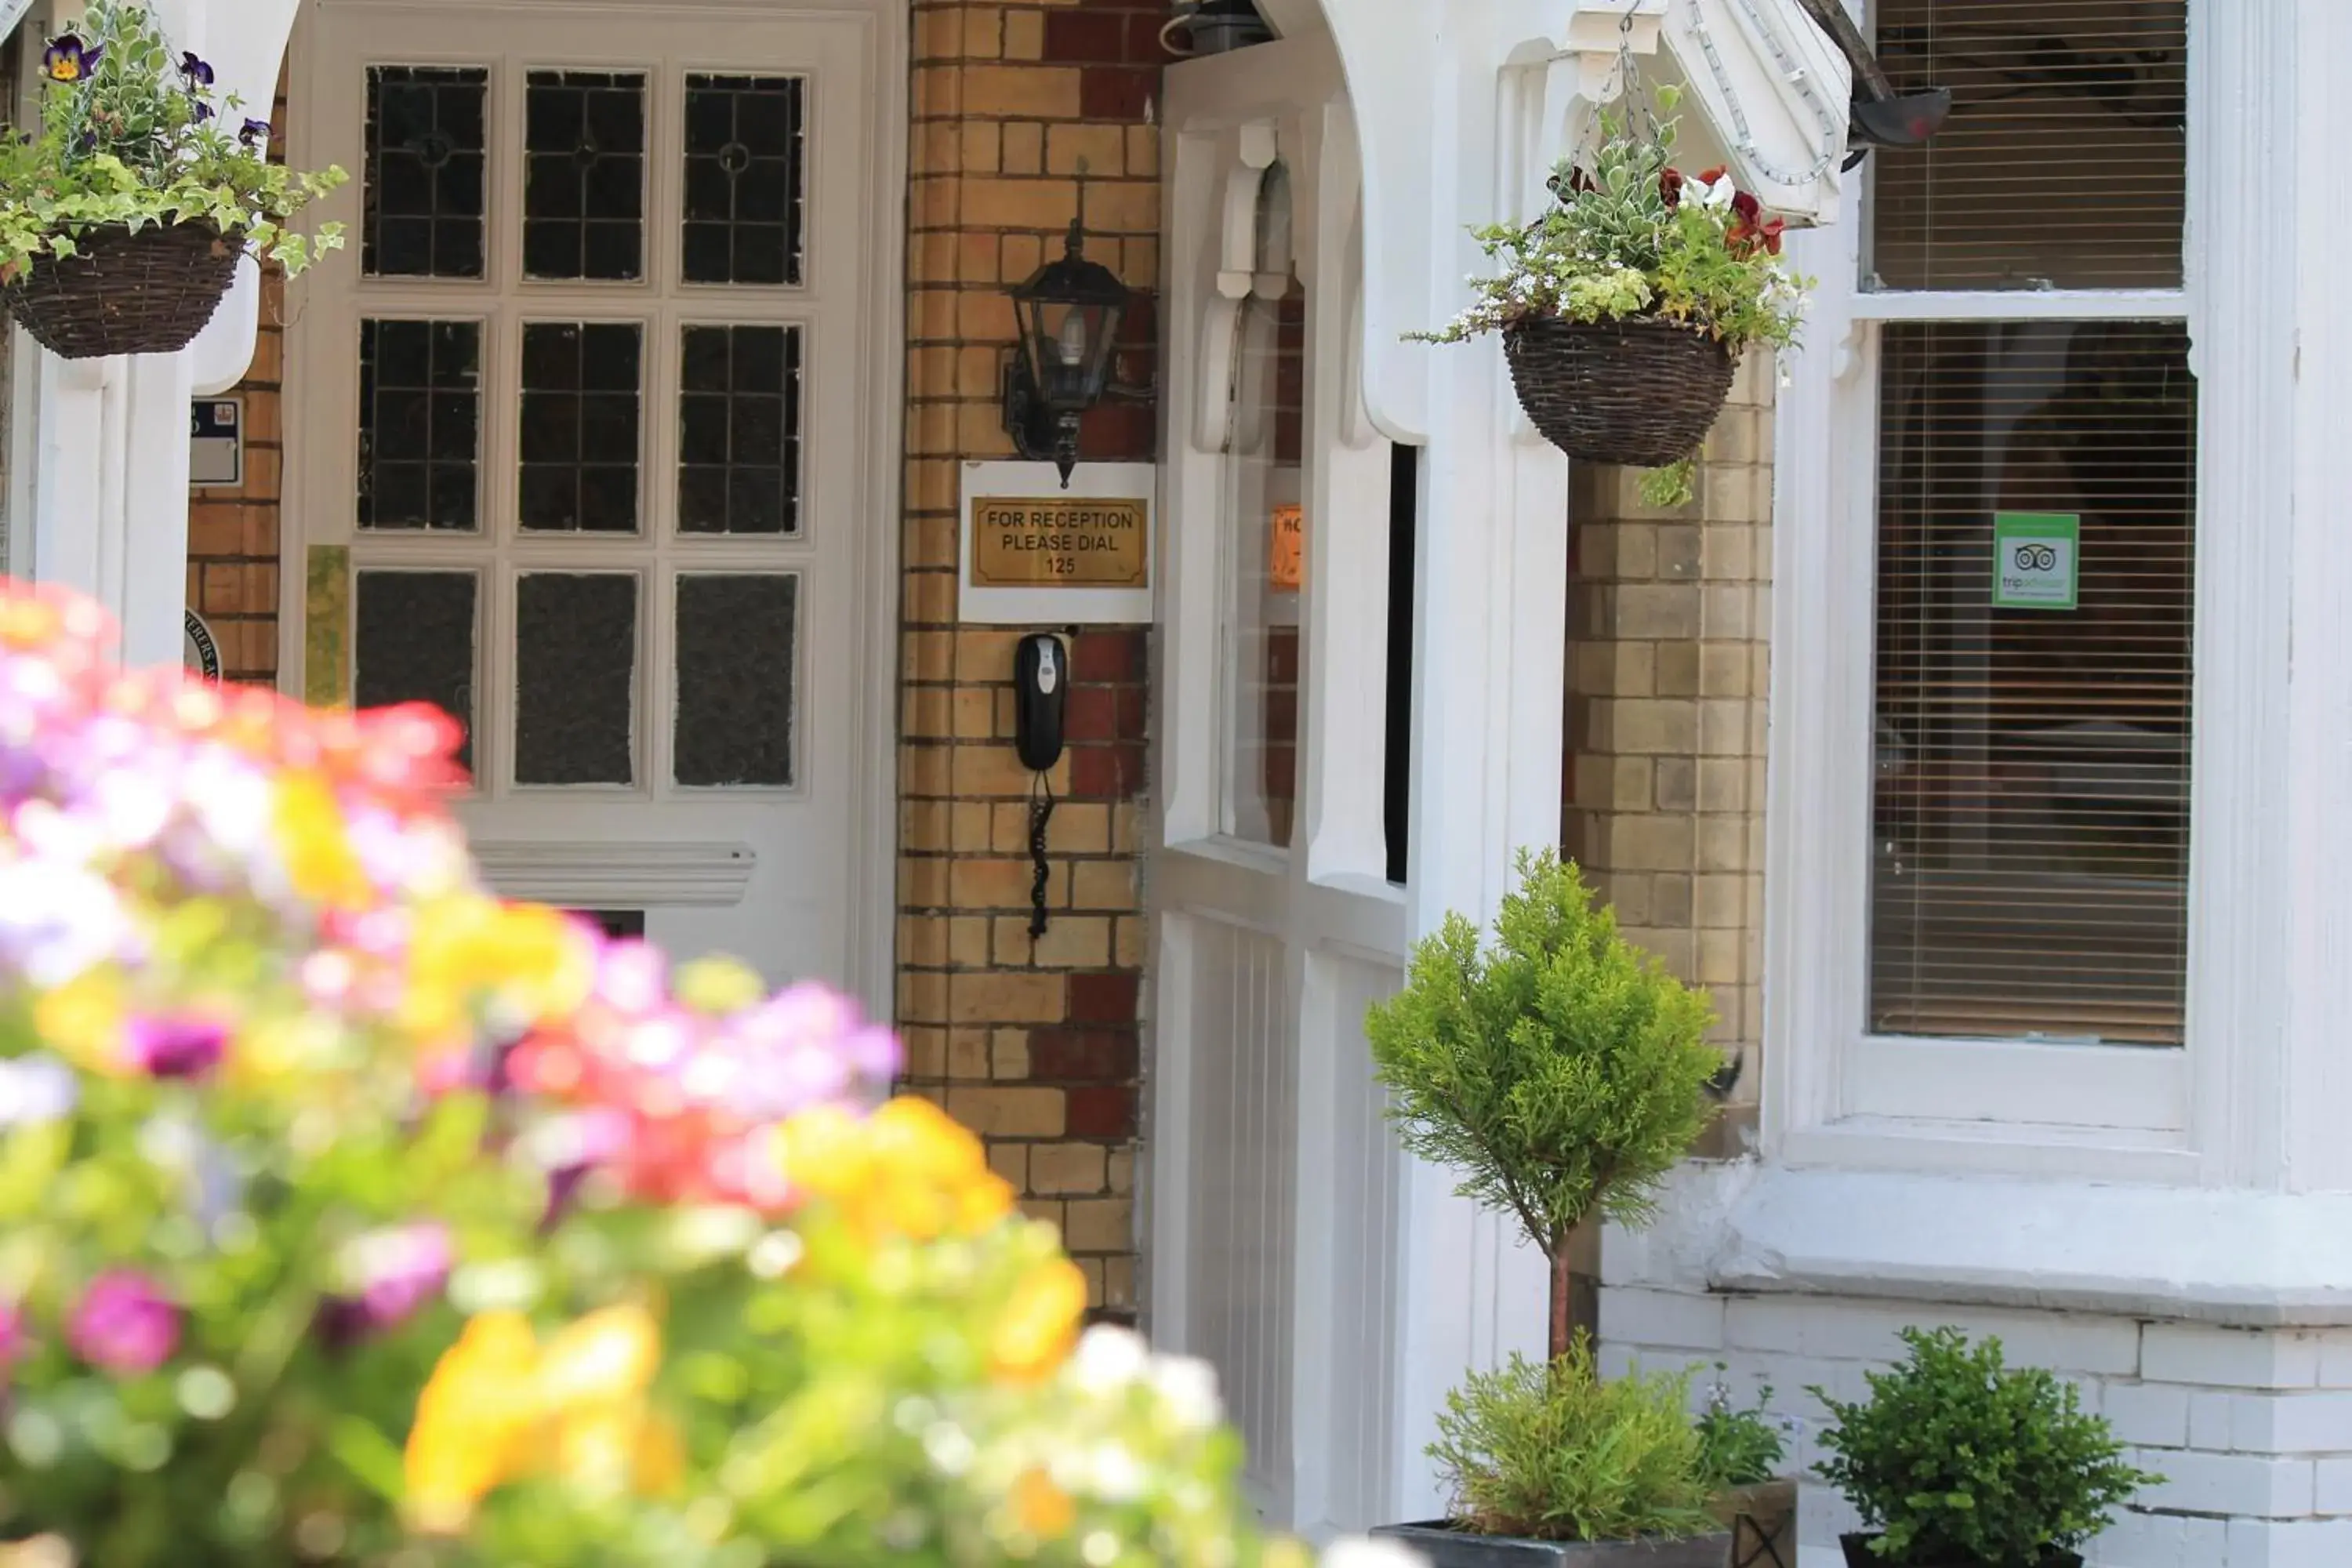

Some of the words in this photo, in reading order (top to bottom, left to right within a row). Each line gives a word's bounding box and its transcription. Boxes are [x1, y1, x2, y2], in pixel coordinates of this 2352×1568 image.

[988, 512, 1024, 528] FOR
[1030, 512, 1133, 528] RECEPTION
[1002, 535, 1072, 551] PLEASE
[1078, 535, 1119, 551] DIAL
[1047, 558, 1075, 573] 125
